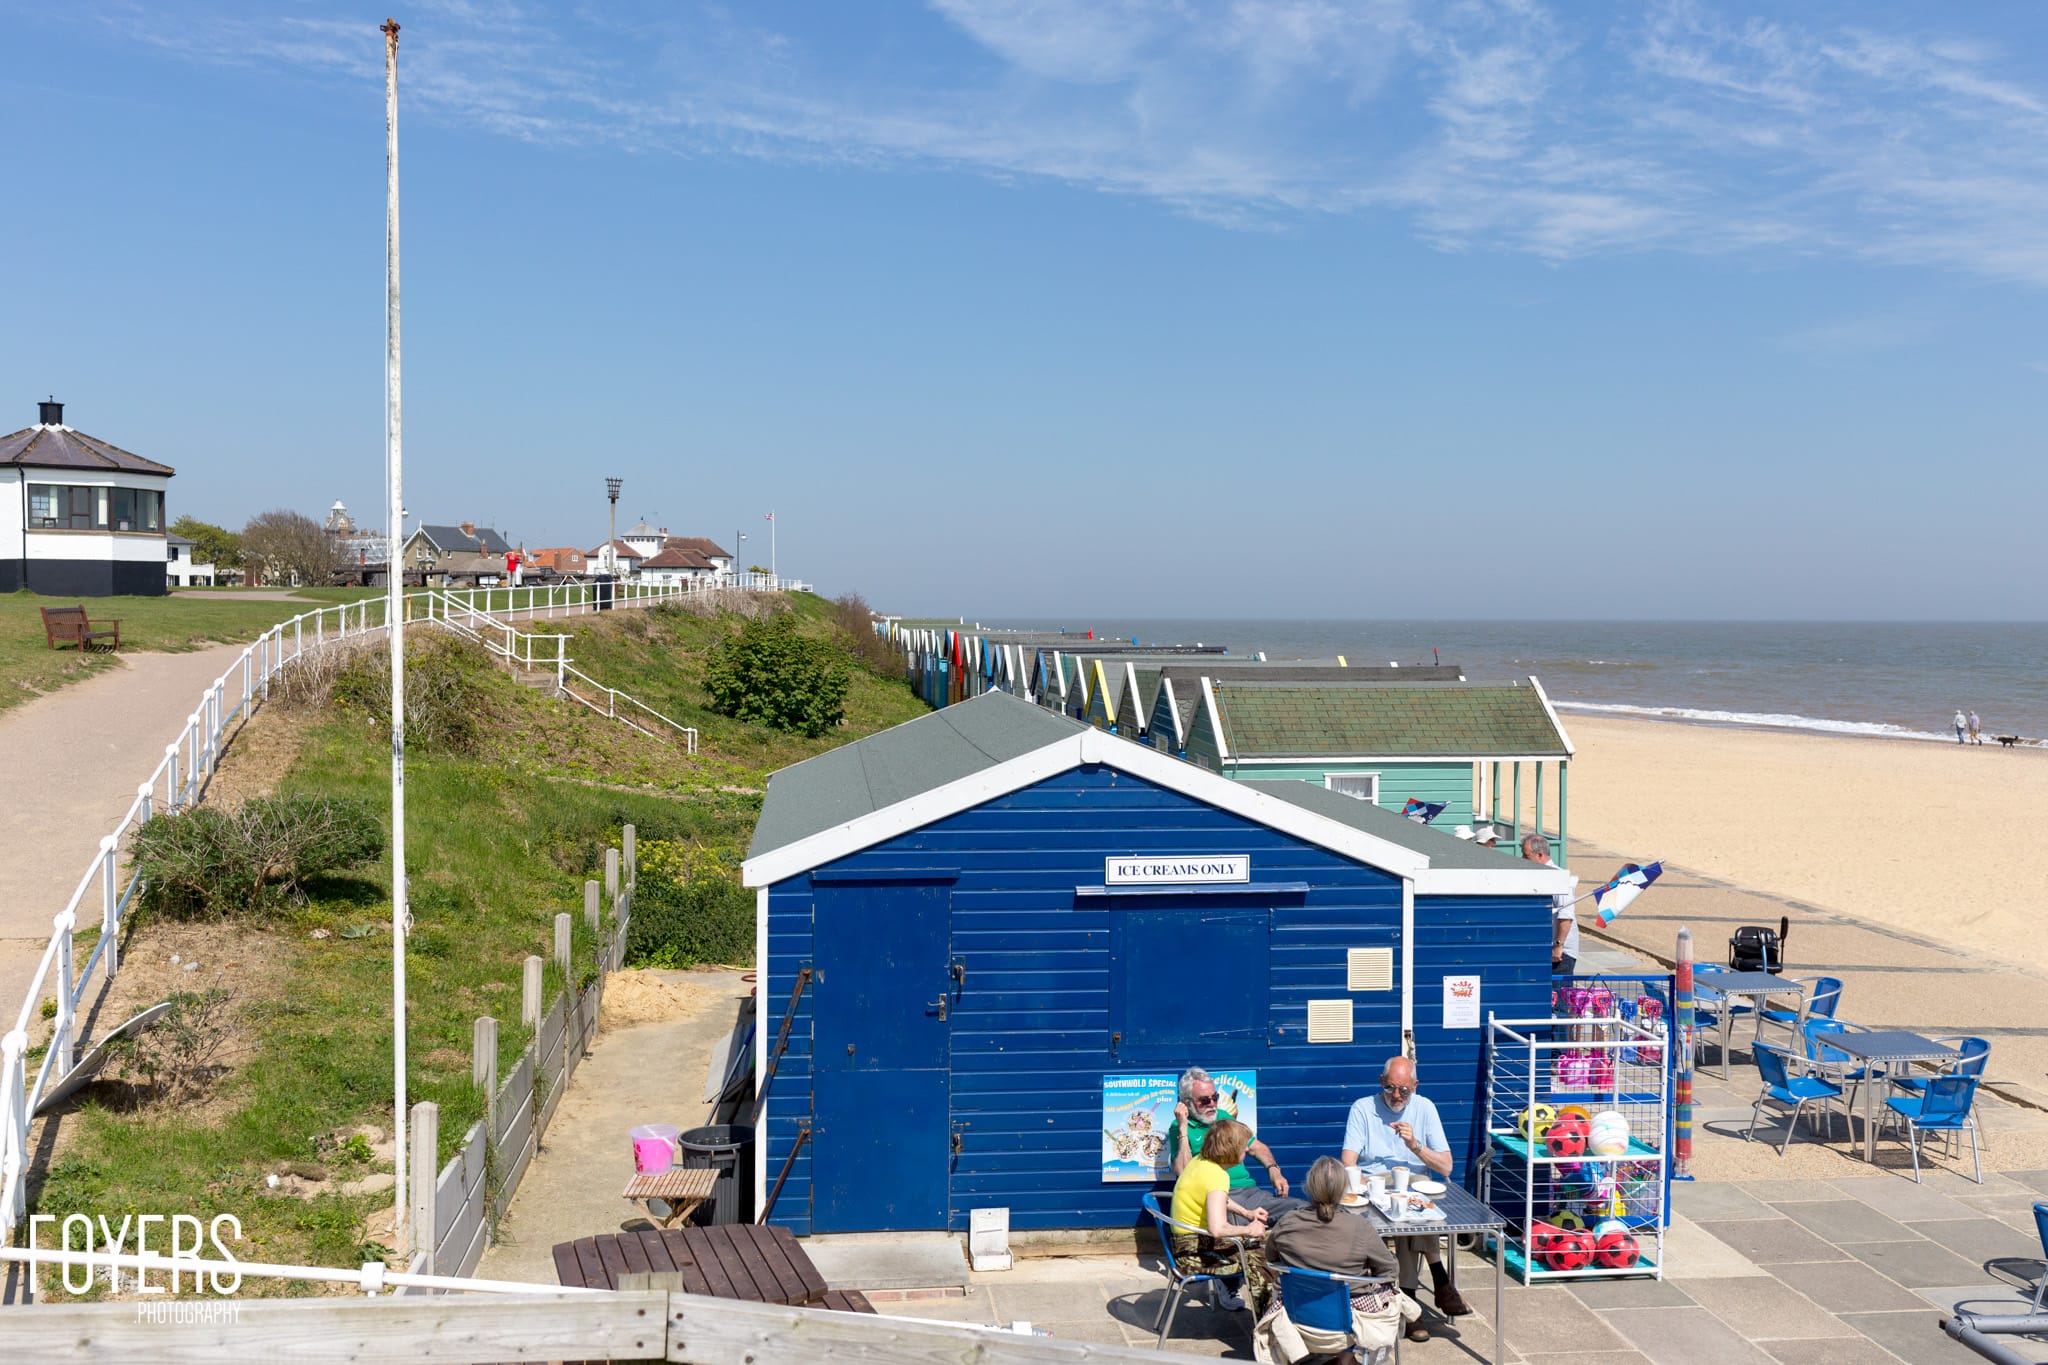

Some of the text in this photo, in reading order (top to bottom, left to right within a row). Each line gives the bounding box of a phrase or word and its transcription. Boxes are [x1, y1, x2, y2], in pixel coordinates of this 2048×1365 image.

[1118, 863, 1237, 876] ICE CREAMS ONLY
[1103, 1078, 1177, 1088] SOUTHWOLD SPECIAL
[1213, 1074, 1255, 1098] elicious
